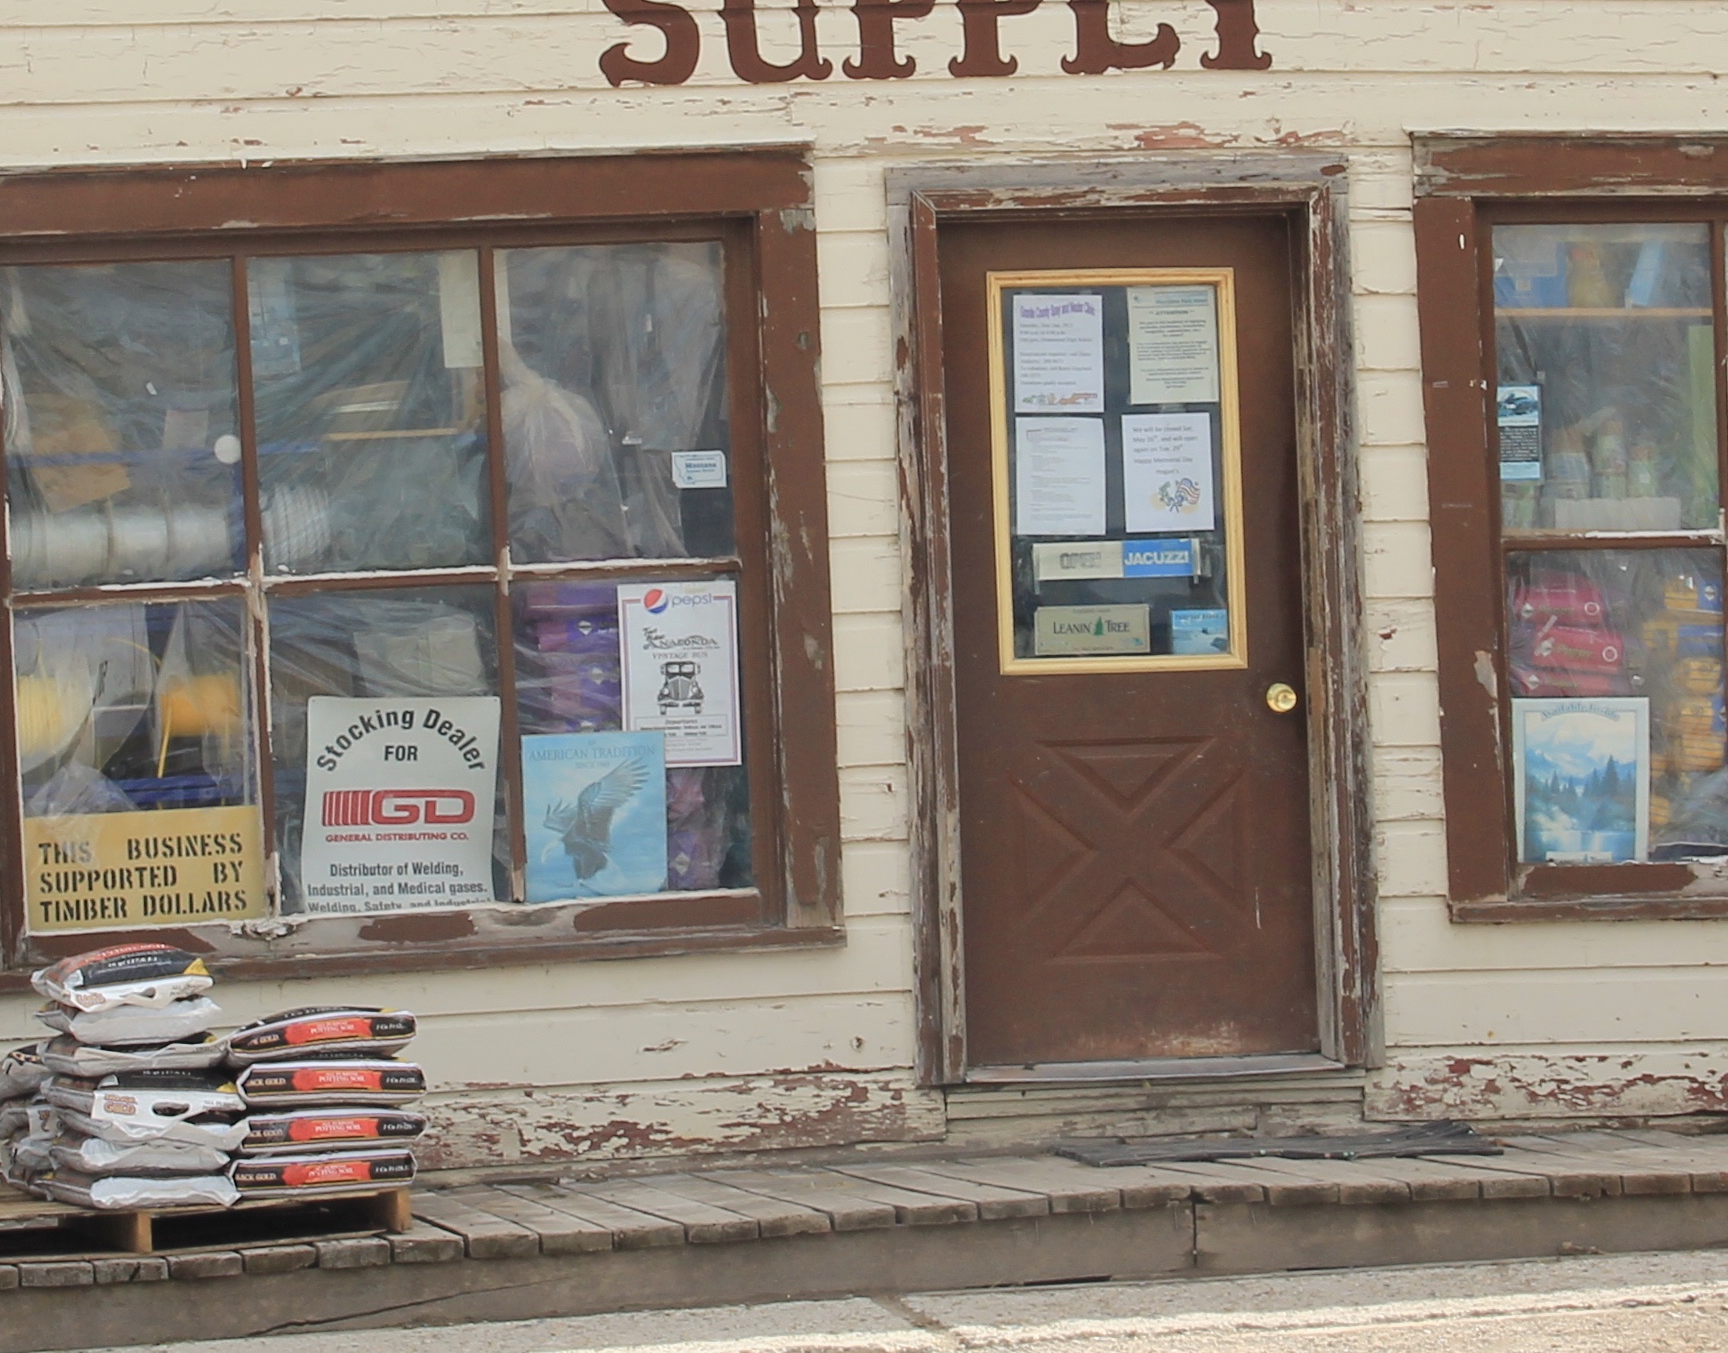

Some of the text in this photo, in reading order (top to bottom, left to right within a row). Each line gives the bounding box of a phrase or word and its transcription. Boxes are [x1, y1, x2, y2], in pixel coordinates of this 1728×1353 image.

[1123, 550, 1189, 566] JACUZZI
[672, 592, 712, 608] pepsi
[1105, 619, 1130, 633] TREE
[316, 708, 486, 773] Stocking Dealer
[384, 745, 419, 762] FOR
[529, 748, 588, 762] AMERICAN
[325, 832, 470, 843] GENERAL DISTRIBUTING CO.
[38, 832, 244, 865] THIS BUSINESS
[39, 860, 244, 894] SUPPORTED BY
[330, 862, 464, 877] Distributor of Welding,
[307, 881, 488, 898] Industrial, and Medical gases.
[39, 889, 248, 923] TIMBER DOLLARS
